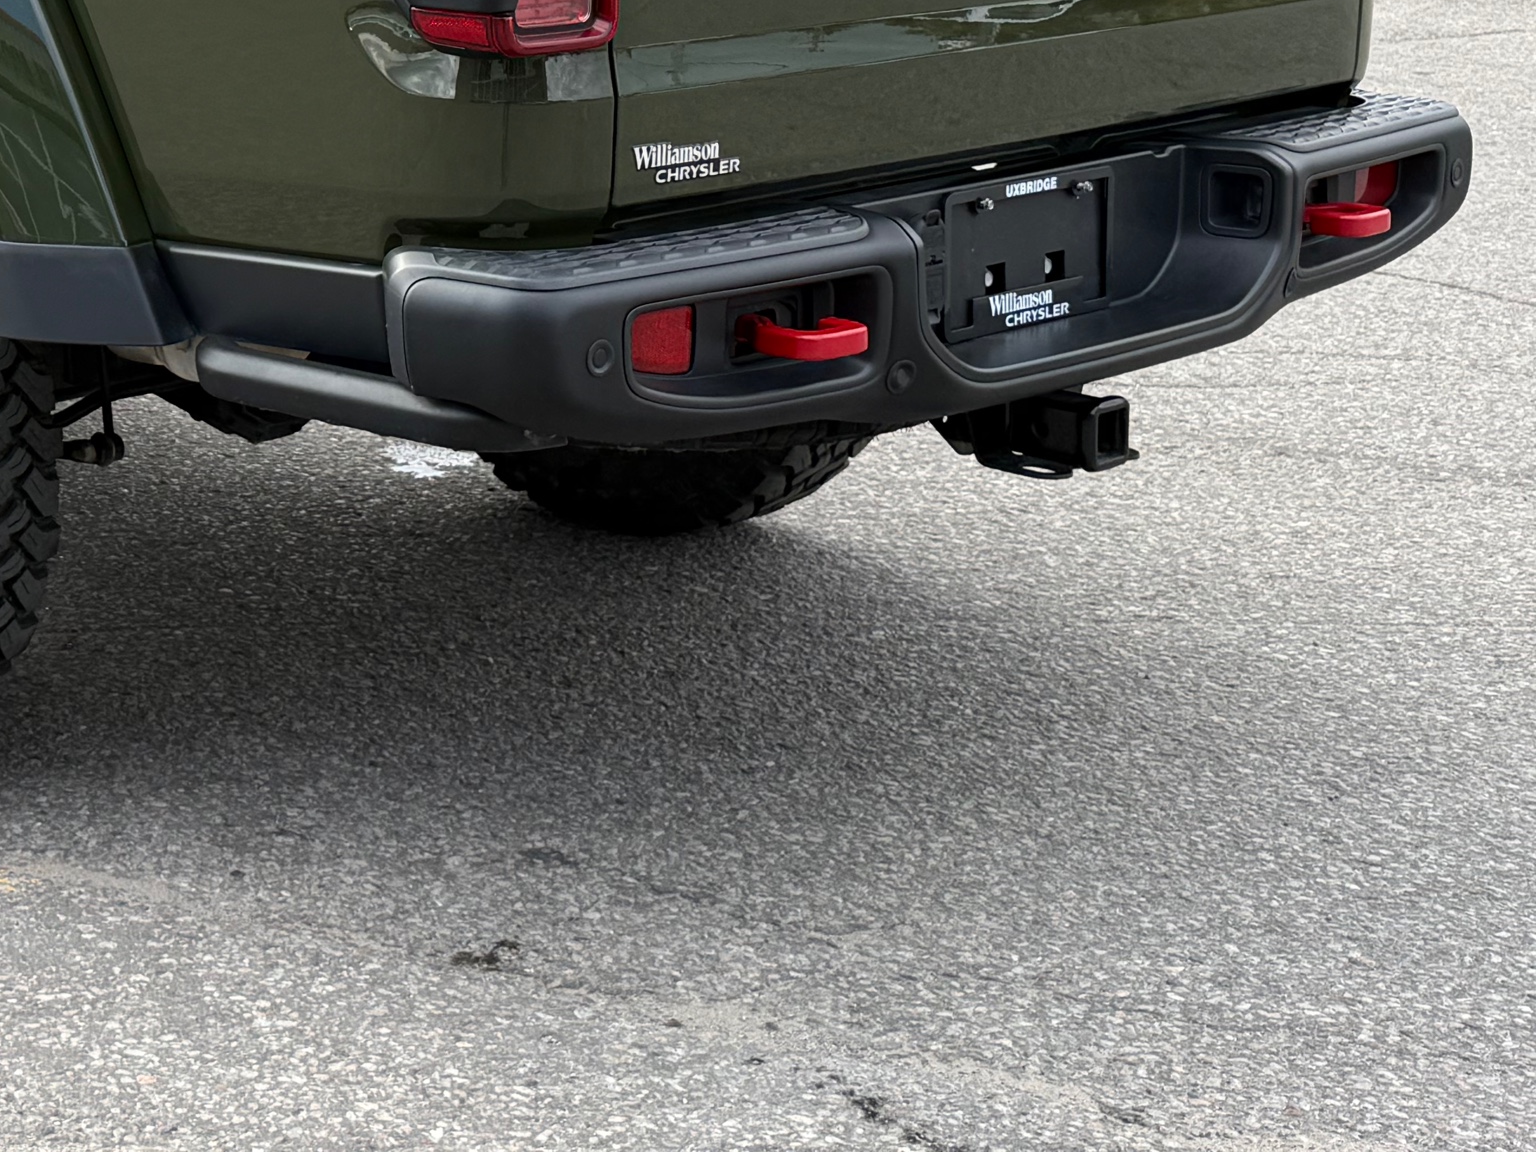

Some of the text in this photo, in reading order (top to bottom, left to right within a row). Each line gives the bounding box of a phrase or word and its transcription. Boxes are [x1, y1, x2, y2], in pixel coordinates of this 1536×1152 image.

[633, 141, 720, 170] Williamson
[655, 158, 741, 184] CHRYSLER
[1005, 176, 1058, 198] UXBRIDGE
[988, 289, 1053, 317] Williamson
[1005, 302, 1070, 328] CHRYSLER
